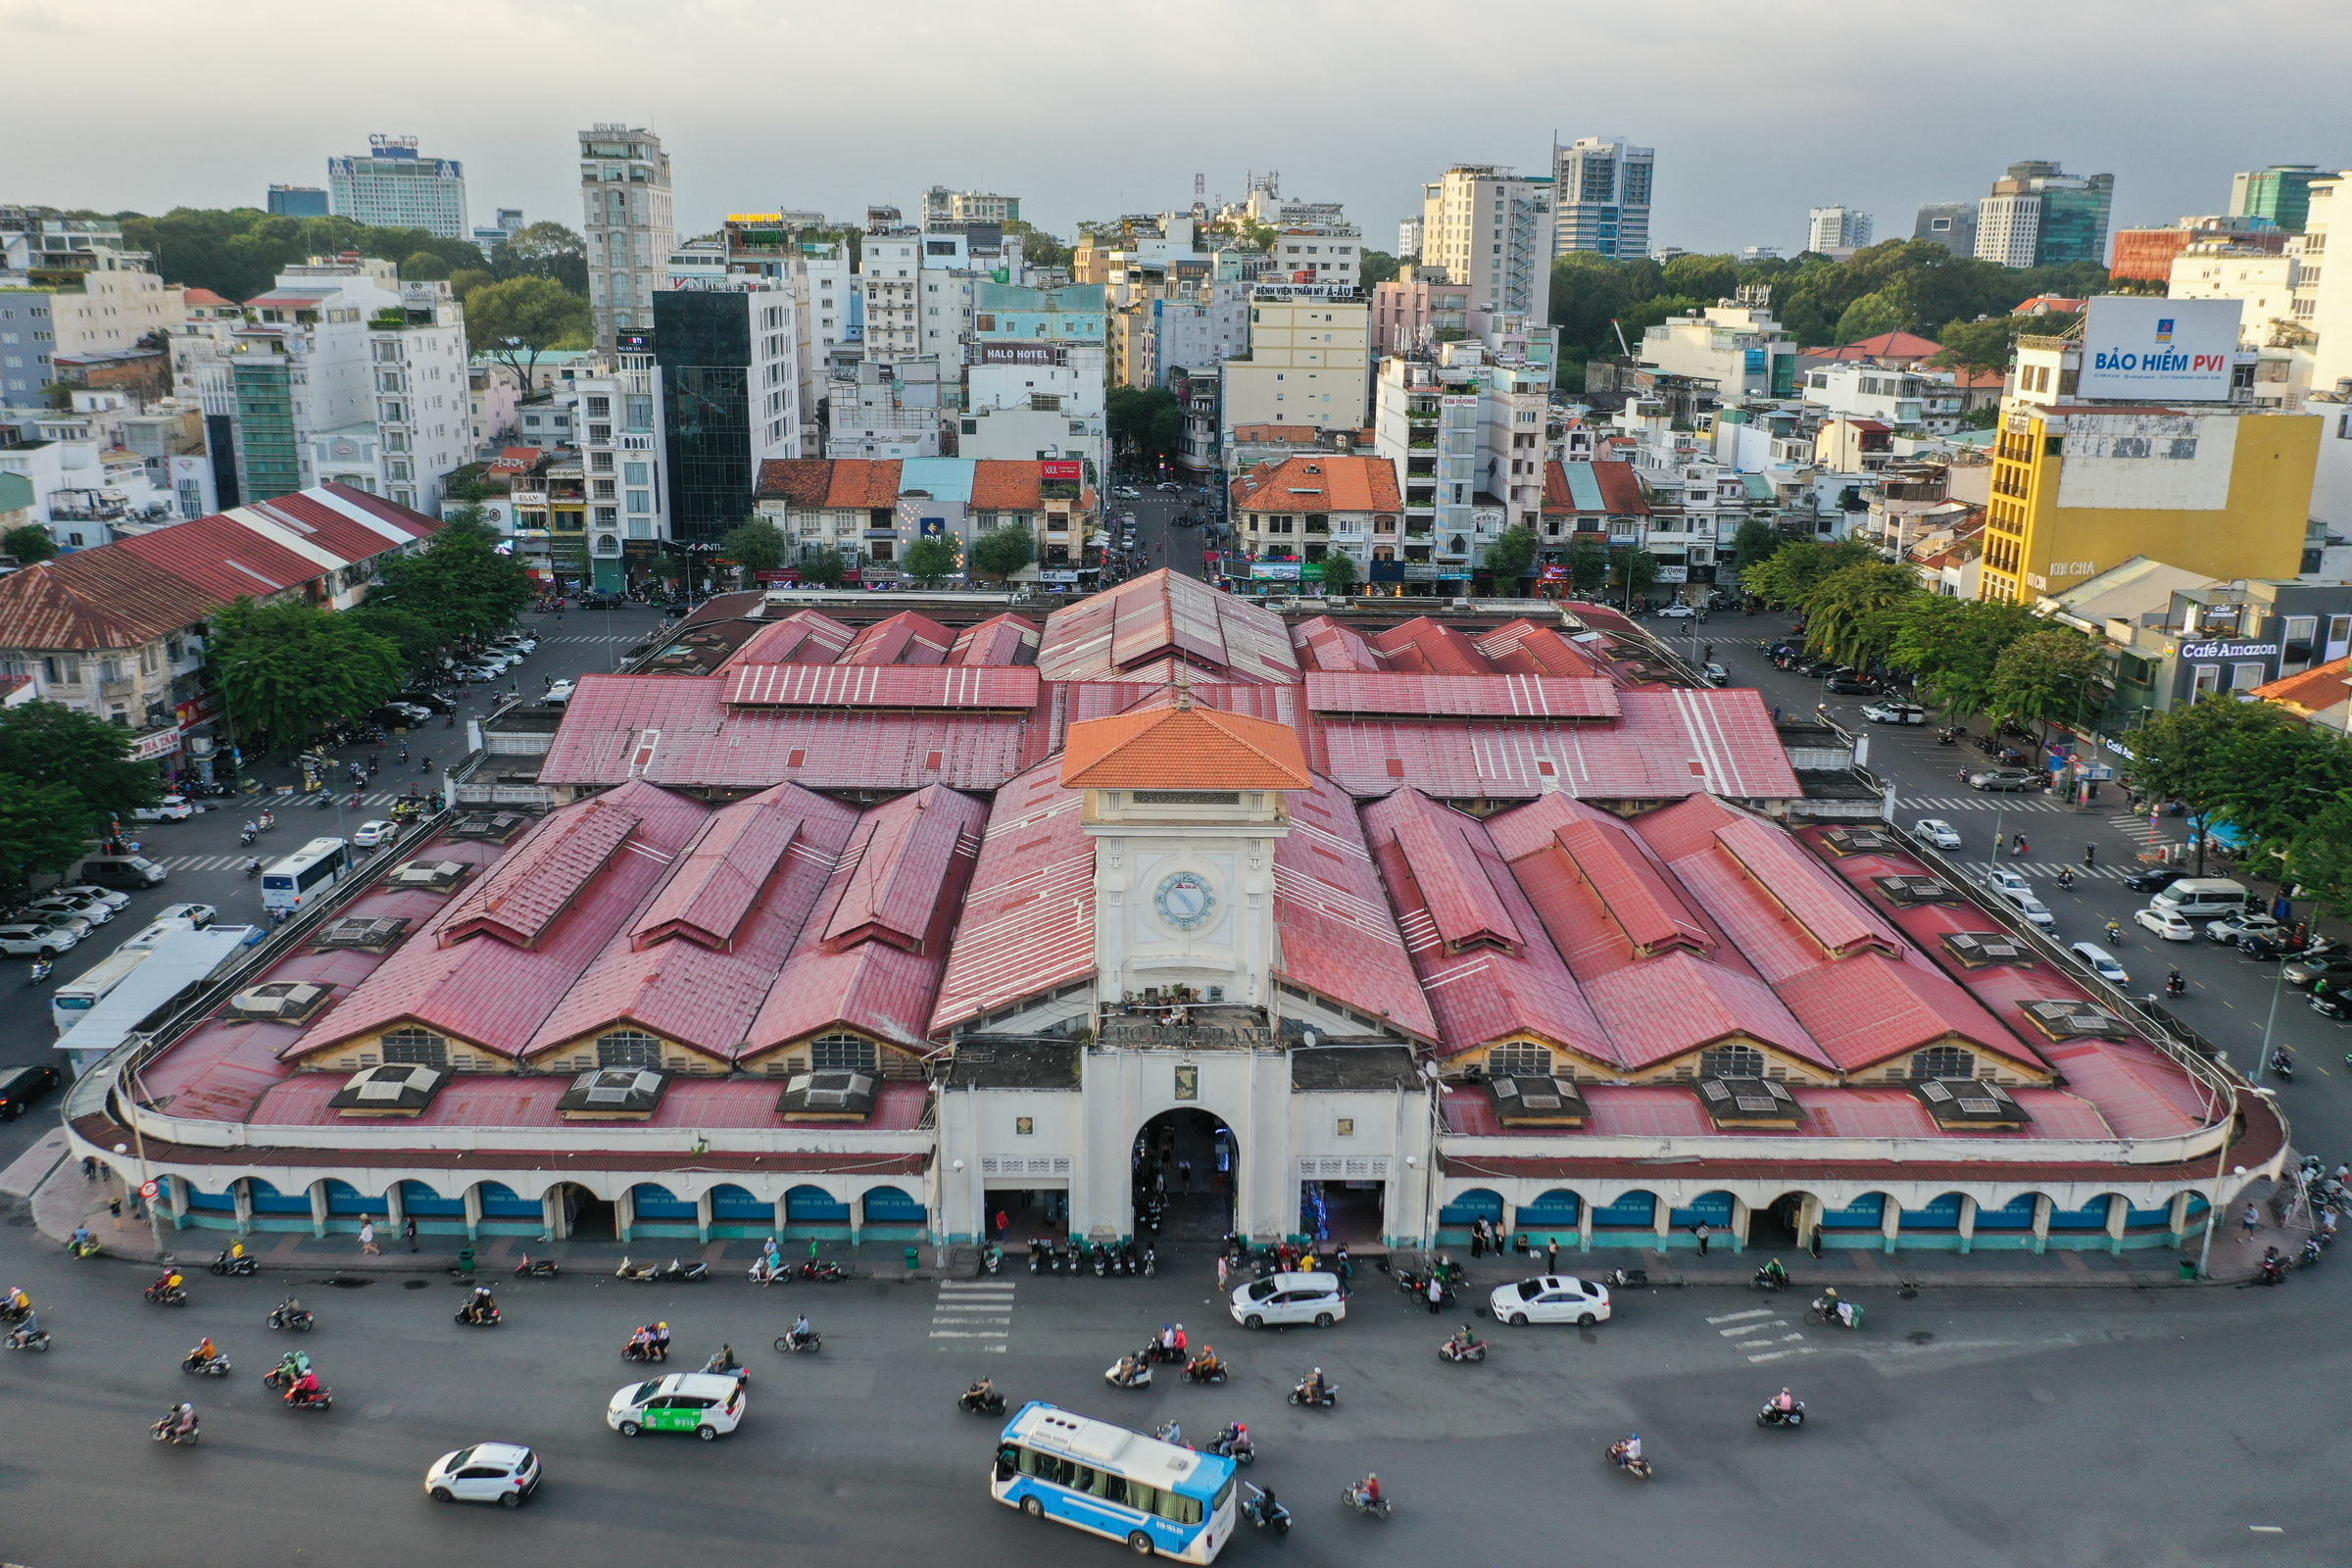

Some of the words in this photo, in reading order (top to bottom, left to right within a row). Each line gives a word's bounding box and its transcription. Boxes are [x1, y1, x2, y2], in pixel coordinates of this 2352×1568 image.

[592, 122, 626, 132] GOLDEN
[988, 349, 1014, 359] HALO
[1017, 349, 1049, 359] HOTEL
[2094, 347, 2137, 371] BẢO
[2142, 345, 2188, 371] HIỂM
[2192, 355, 2225, 371] PVI
[1045, 465, 1058, 474] SOUL
[2050, 563, 2068, 576] KOI
[2070, 562, 2095, 575] CHA
[2034, 575, 2046, 591] CHA
[2181, 641, 2218, 659] Café
[2217, 643, 2278, 658] Amazon
[143, 737, 159, 753] HÀ
[2105, 739, 2123, 755] Café
[1179, 872, 1193, 882] 12
[1155, 894, 1165, 905] 9
[1206, 896, 1215, 906] 3
[1180, 919, 1190, 928] 6
[1102, 1023, 1144, 1042] CHỢ
[1198, 1023, 1271, 1044] THÀNH
